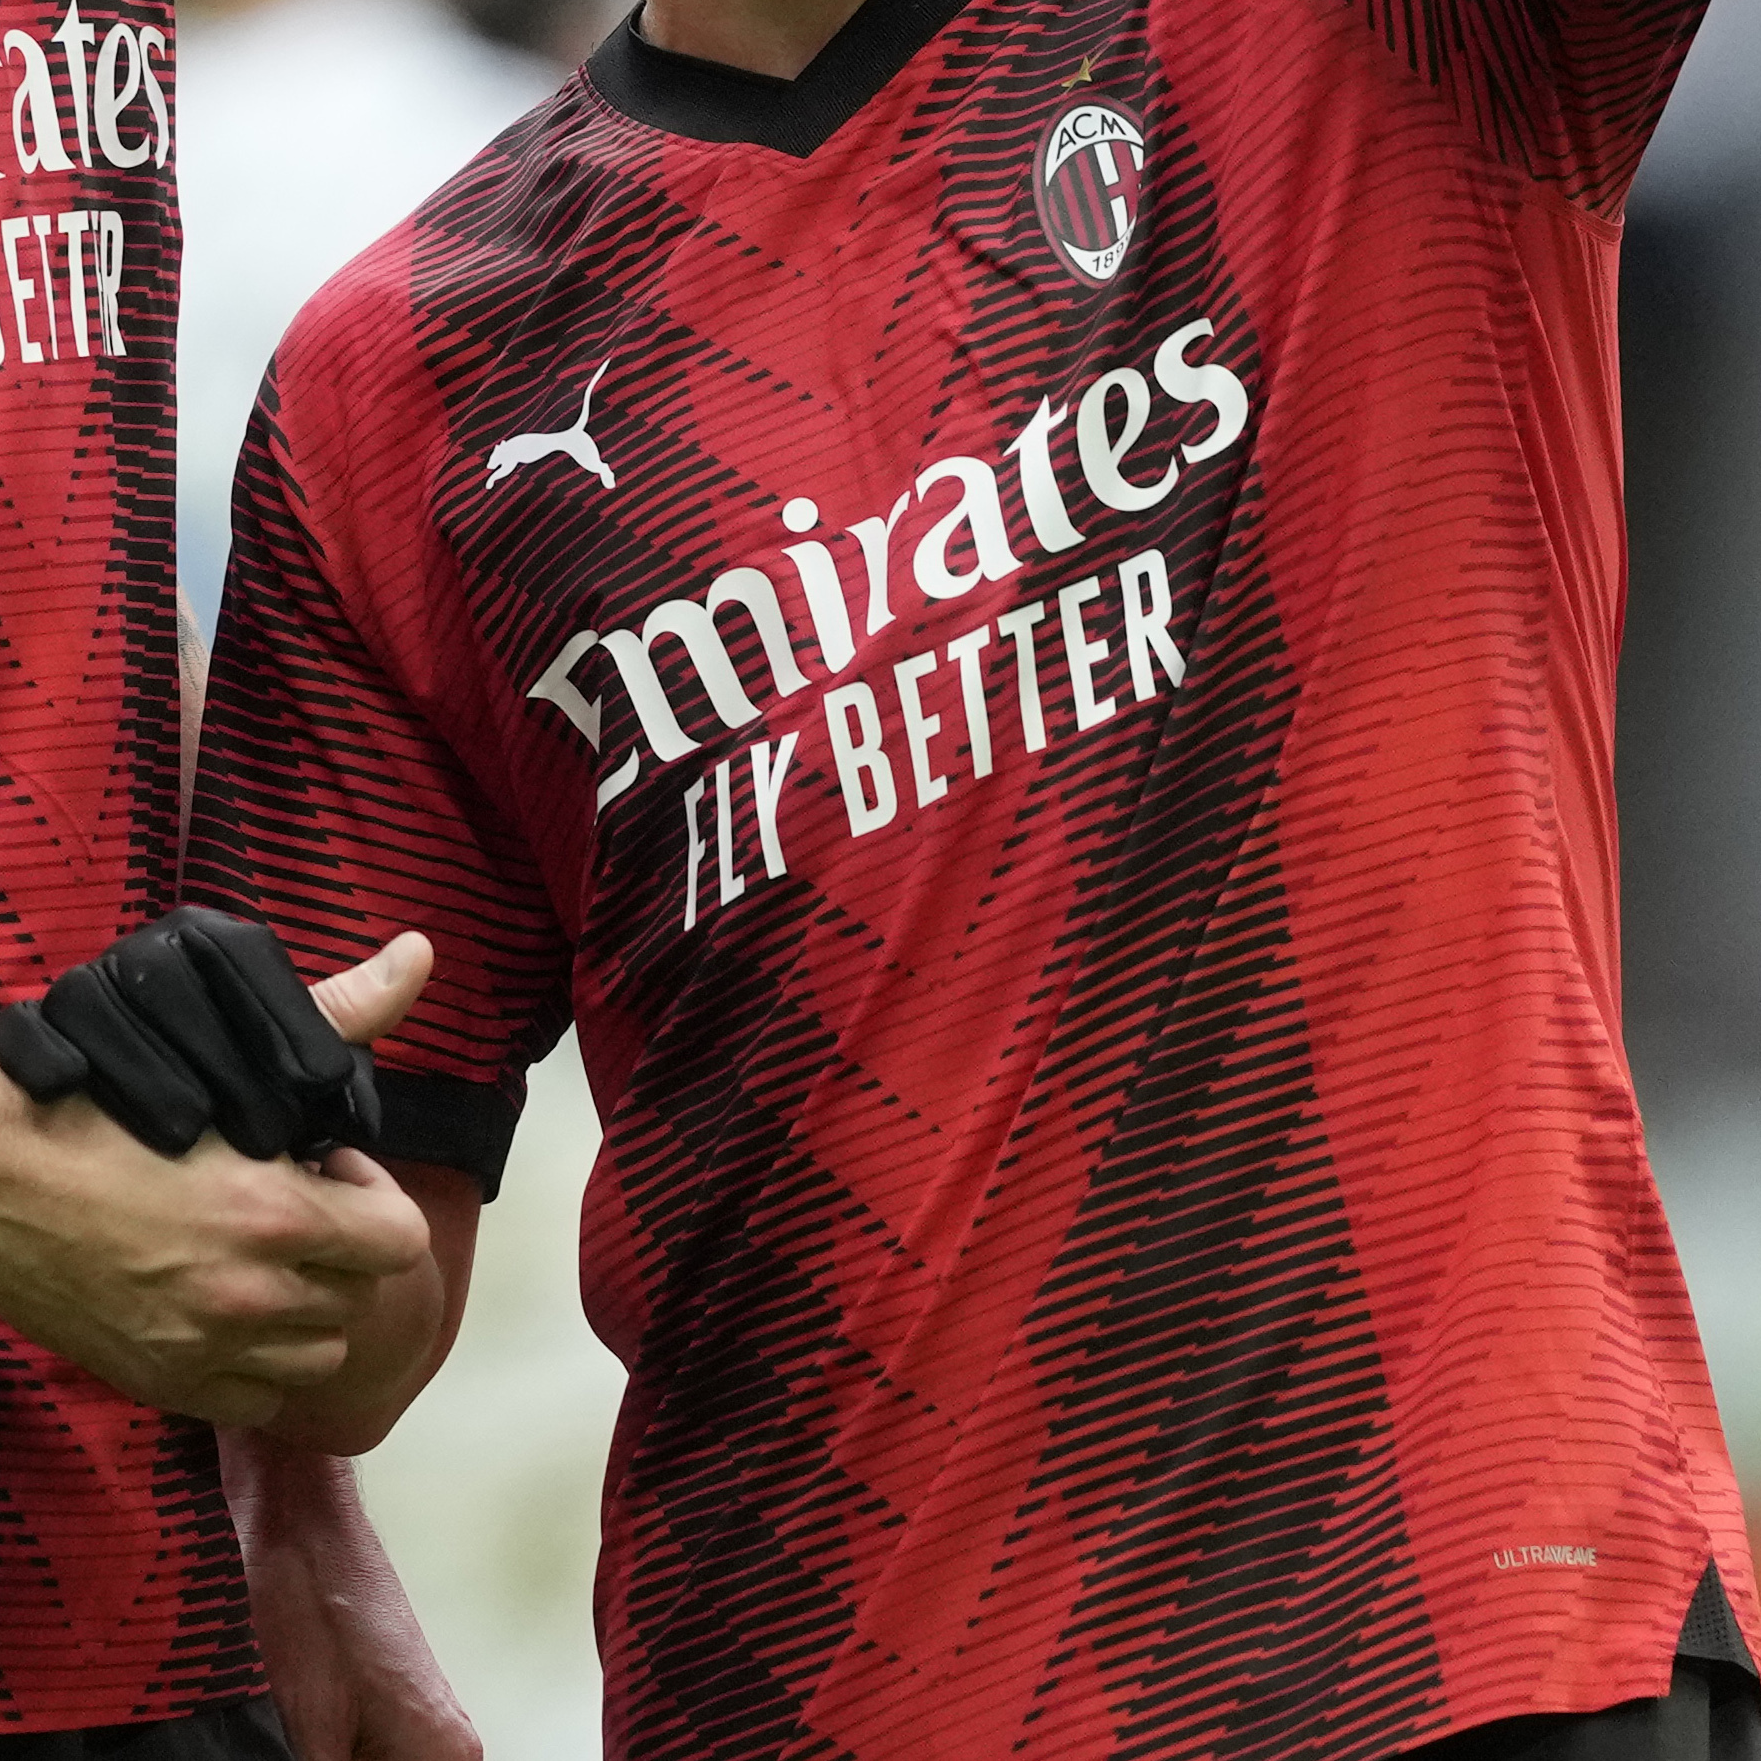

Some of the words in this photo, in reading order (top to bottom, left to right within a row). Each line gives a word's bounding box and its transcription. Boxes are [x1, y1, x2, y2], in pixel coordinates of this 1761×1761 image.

[1055, 112, 1127, 164] ACM
[525, 317, 1250, 826] Emirates
[683, 730, 801, 933] FLY
[823, 548, 1188, 839] BETTER
[1492, 1544, 1598, 1570] ULTRAWEAVE
